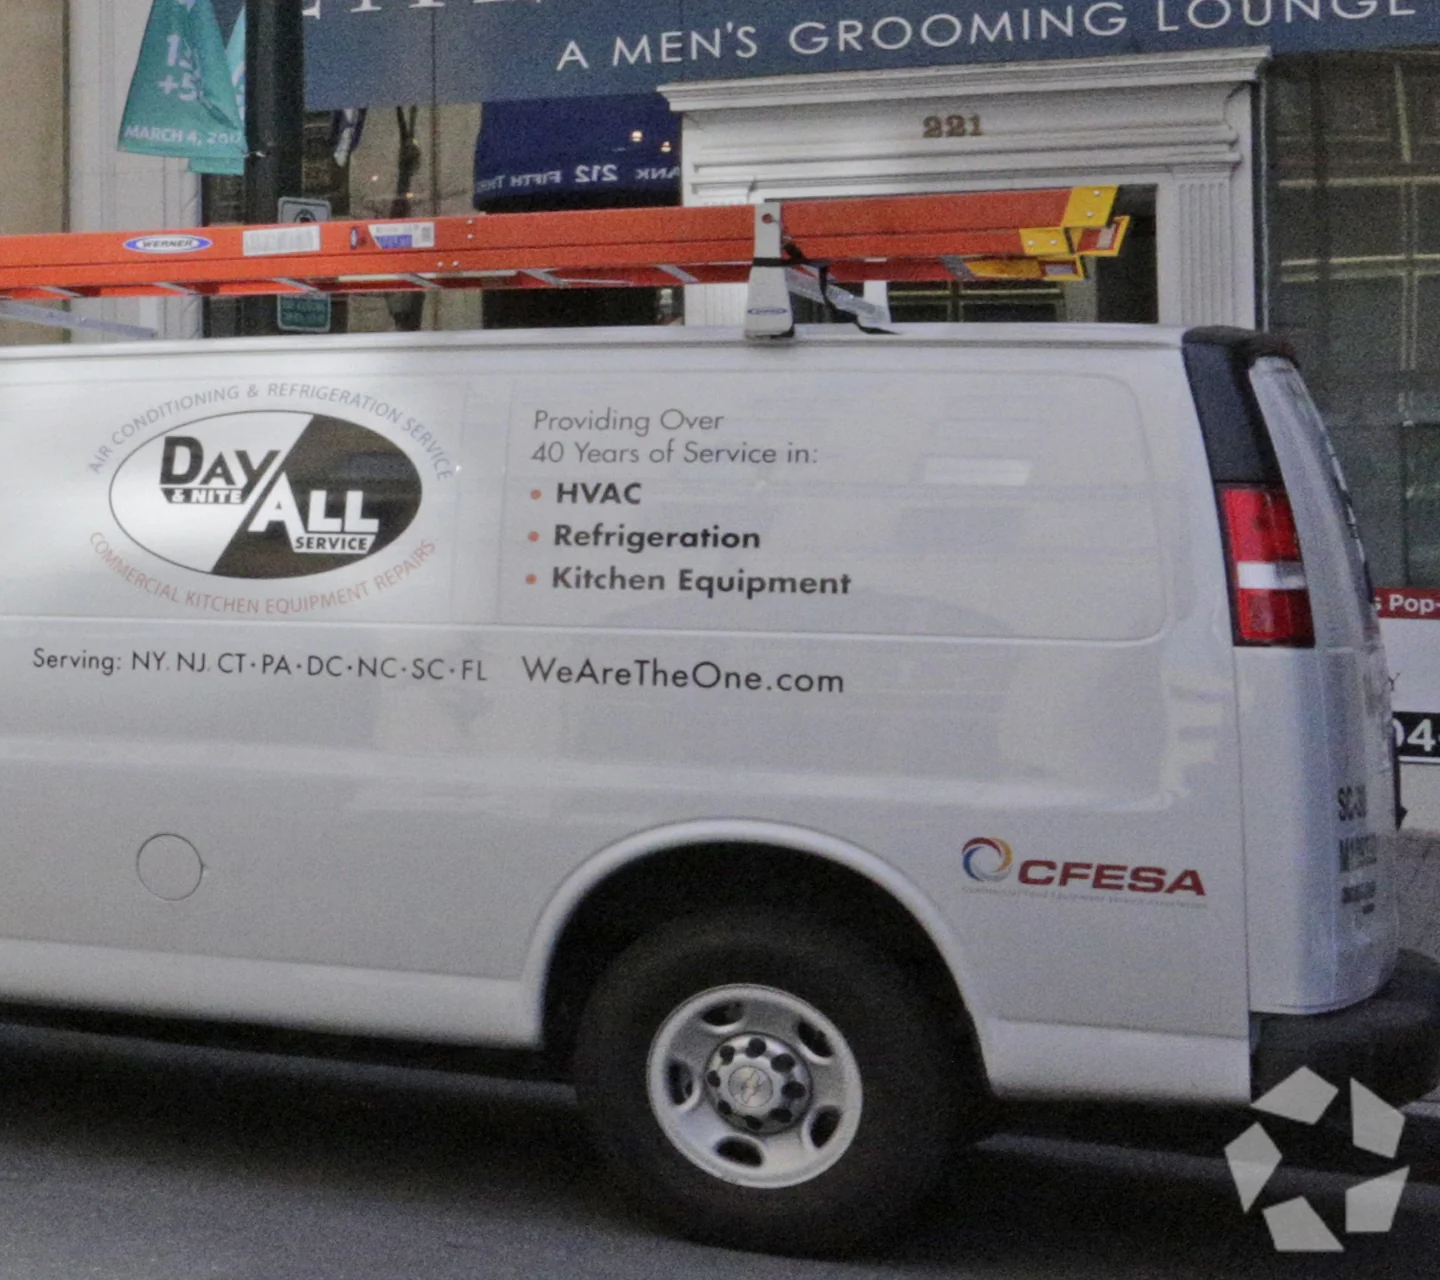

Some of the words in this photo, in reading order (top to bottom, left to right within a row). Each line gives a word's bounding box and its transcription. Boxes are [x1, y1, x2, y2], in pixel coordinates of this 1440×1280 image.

[556, 40, 590, 71] A
[612, 20, 760, 67] MEN'S
[789, 1, 1129, 55] GROOMING
[124, 124, 184, 142] MARCH
[922, 114, 986, 138] 221
[142, 239, 194, 249] WERNER
[89, 444, 114, 475] AIR
[112, 385, 240, 446] CONDITIONING
[246, 384, 259, 399] &
[267, 382, 402, 425] REFRIGERATION
[401, 417, 454, 482] SERVICE
[534, 407, 651, 437] Providing
[660, 408, 725, 431] Over
[531, 441, 565, 464] 40
[574, 441, 640, 464] Years
[649, 438, 676, 464] of
[683, 441, 777, 464] Service
[787, 444, 819, 464] in:
[190, 488, 243, 504] NITE
[557, 482, 643, 505] HVAC
[294, 536, 369, 552] SERVICE
[554, 523, 761, 554] Refrigeration
[90, 532, 180, 603] COMMERCIAL
[185, 590, 260, 614] KITCHEN
[266, 580, 370, 615] EQUIPMENT
[374, 539, 437, 590] REPAIRS
[552, 566, 666, 591] Kitchen
[679, 569, 852, 600] Equipment
[33, 647, 122, 676] Serving:
[521, 655, 845, 693] WeAreTheOne.com
[1017, 858, 1208, 897] CFESA
